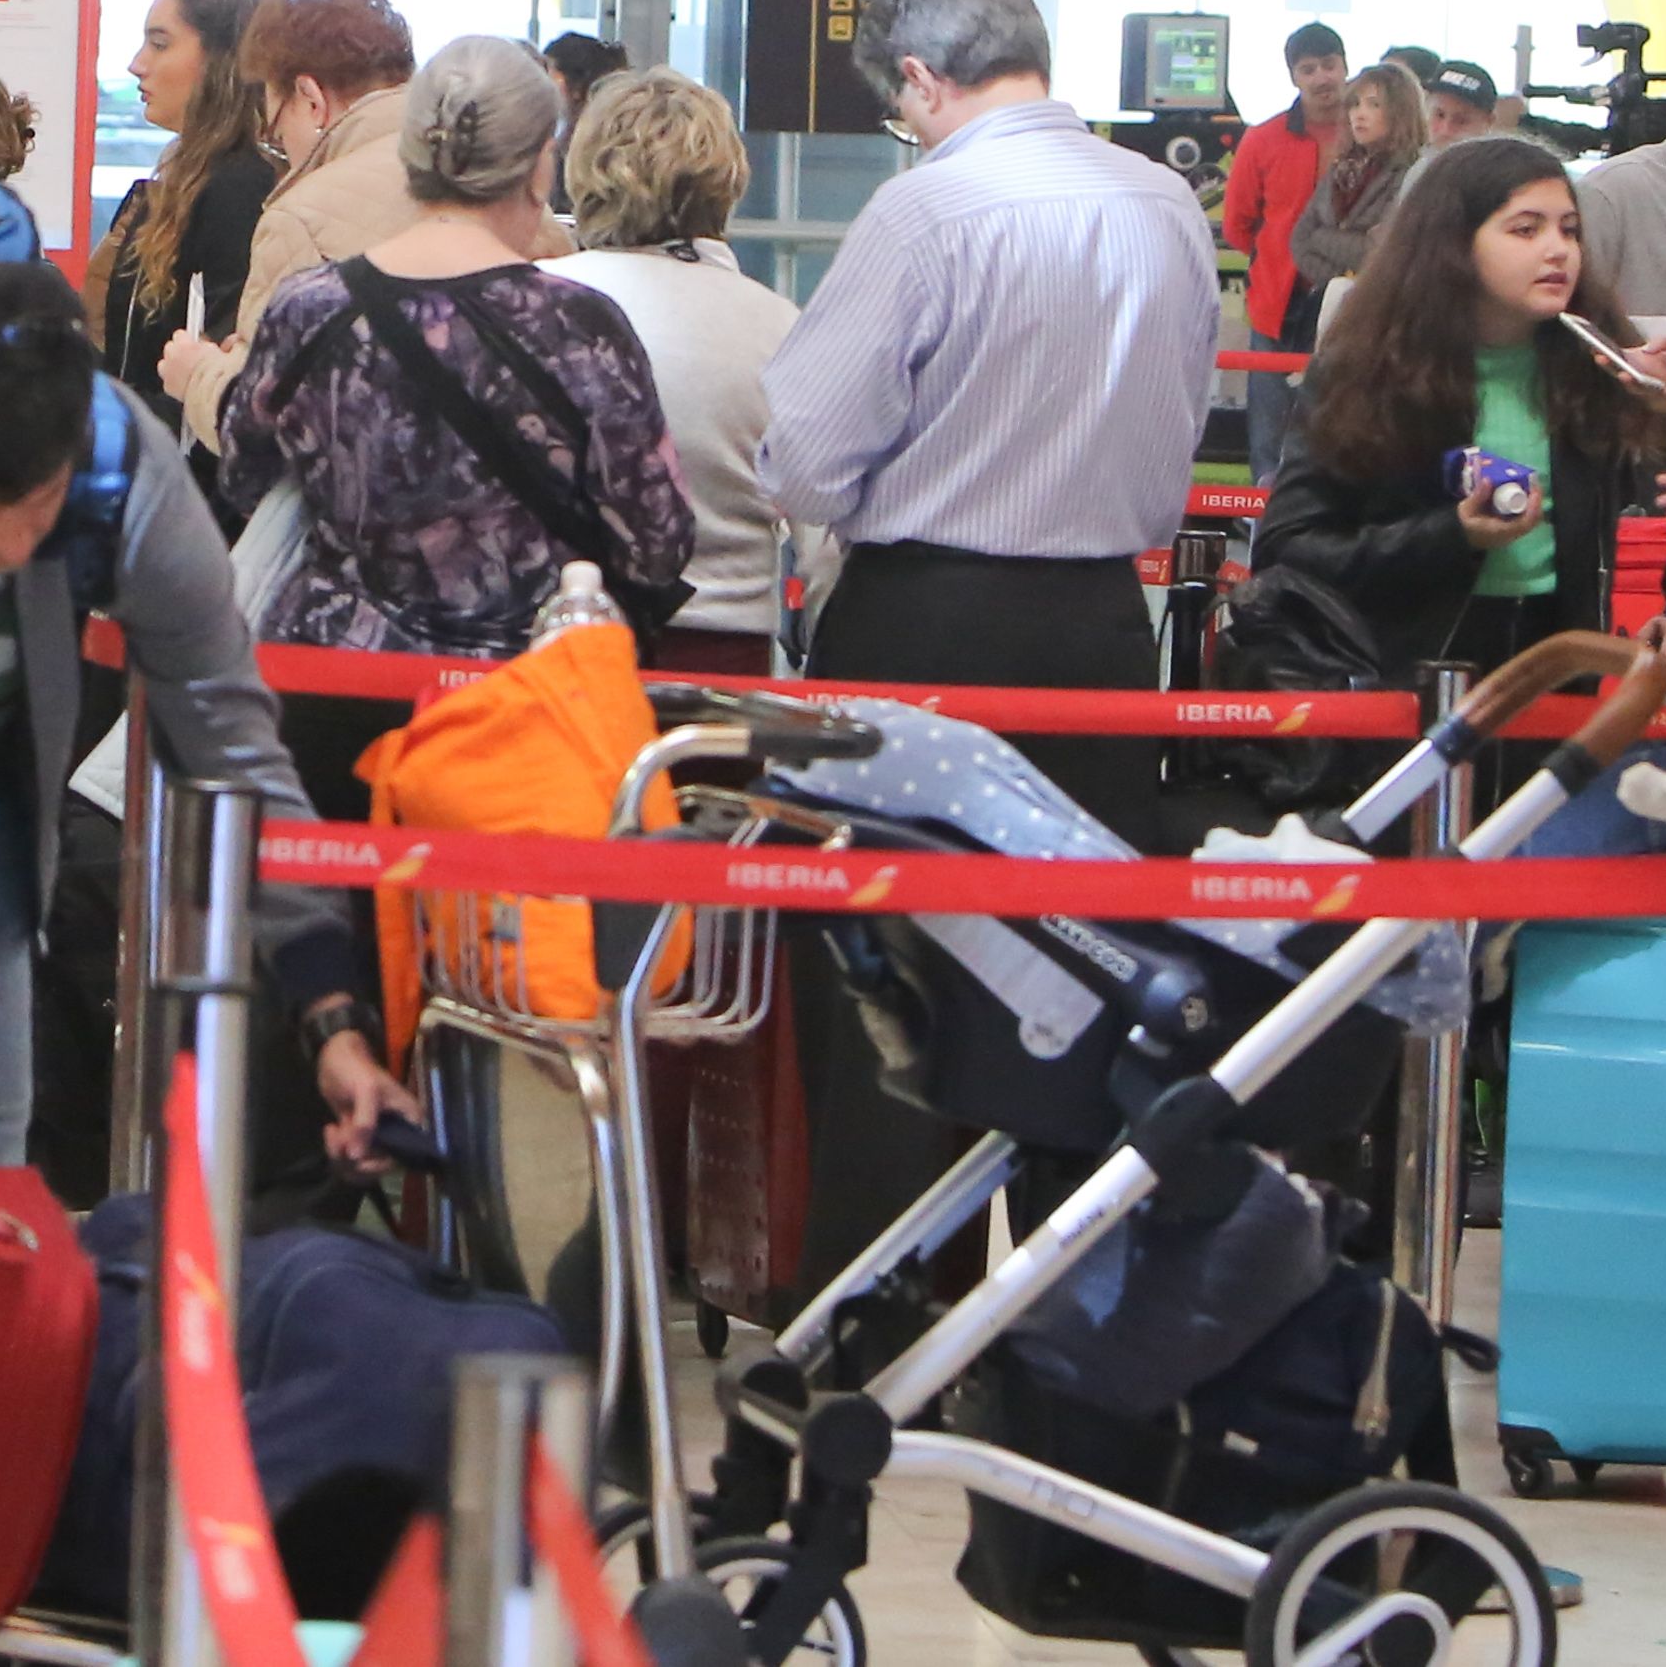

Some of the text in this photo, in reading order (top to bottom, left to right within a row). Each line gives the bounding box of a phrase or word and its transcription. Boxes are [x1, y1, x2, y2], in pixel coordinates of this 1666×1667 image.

[1201, 494, 1266, 510] IBERIA
[1176, 703, 1275, 723] IBERIA
[258, 837, 381, 866] IBERIA
[726, 862, 850, 891] IBERIA
[1191, 875, 1312, 901] IBERIA
